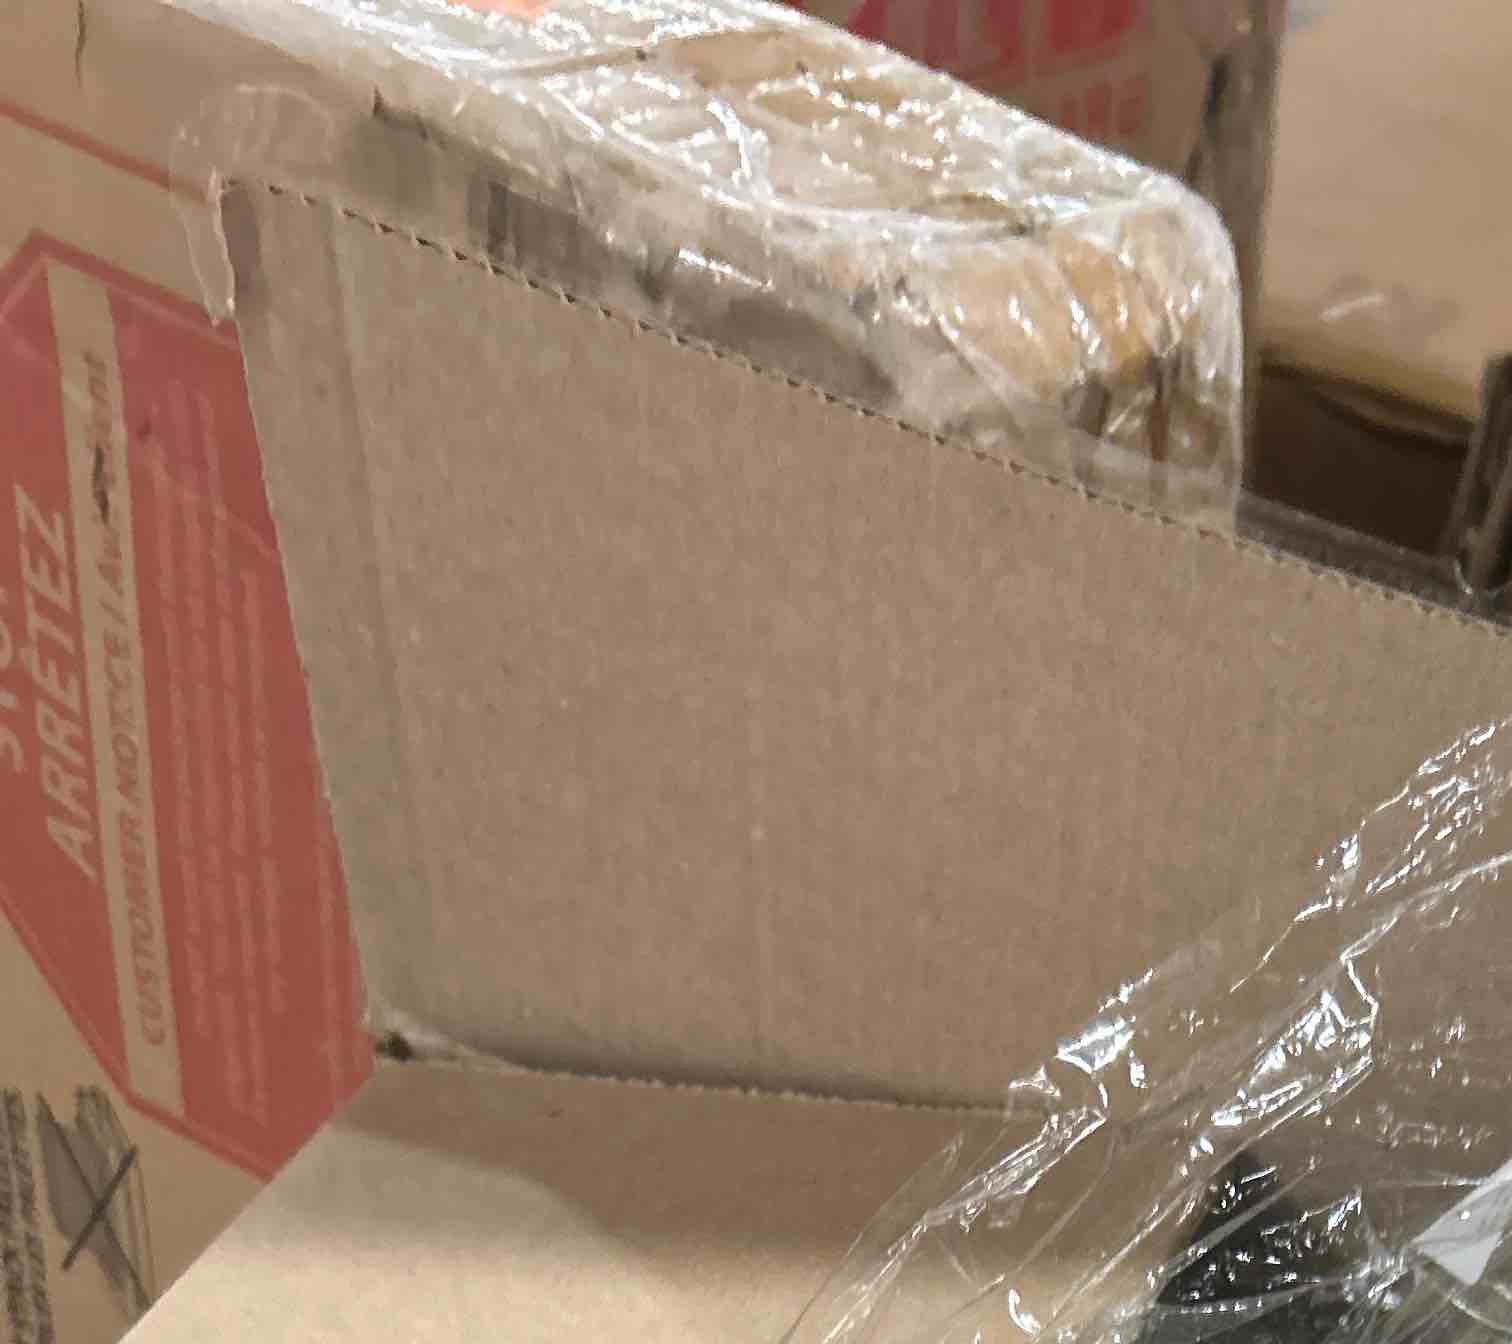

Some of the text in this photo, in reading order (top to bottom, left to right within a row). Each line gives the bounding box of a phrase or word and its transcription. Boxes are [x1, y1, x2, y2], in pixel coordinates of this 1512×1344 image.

[13, 482, 97, 881] ARRÊTEZ
[102, 629, 140, 799] NOTICE
[117, 806, 166, 1046] CUSTOMER
